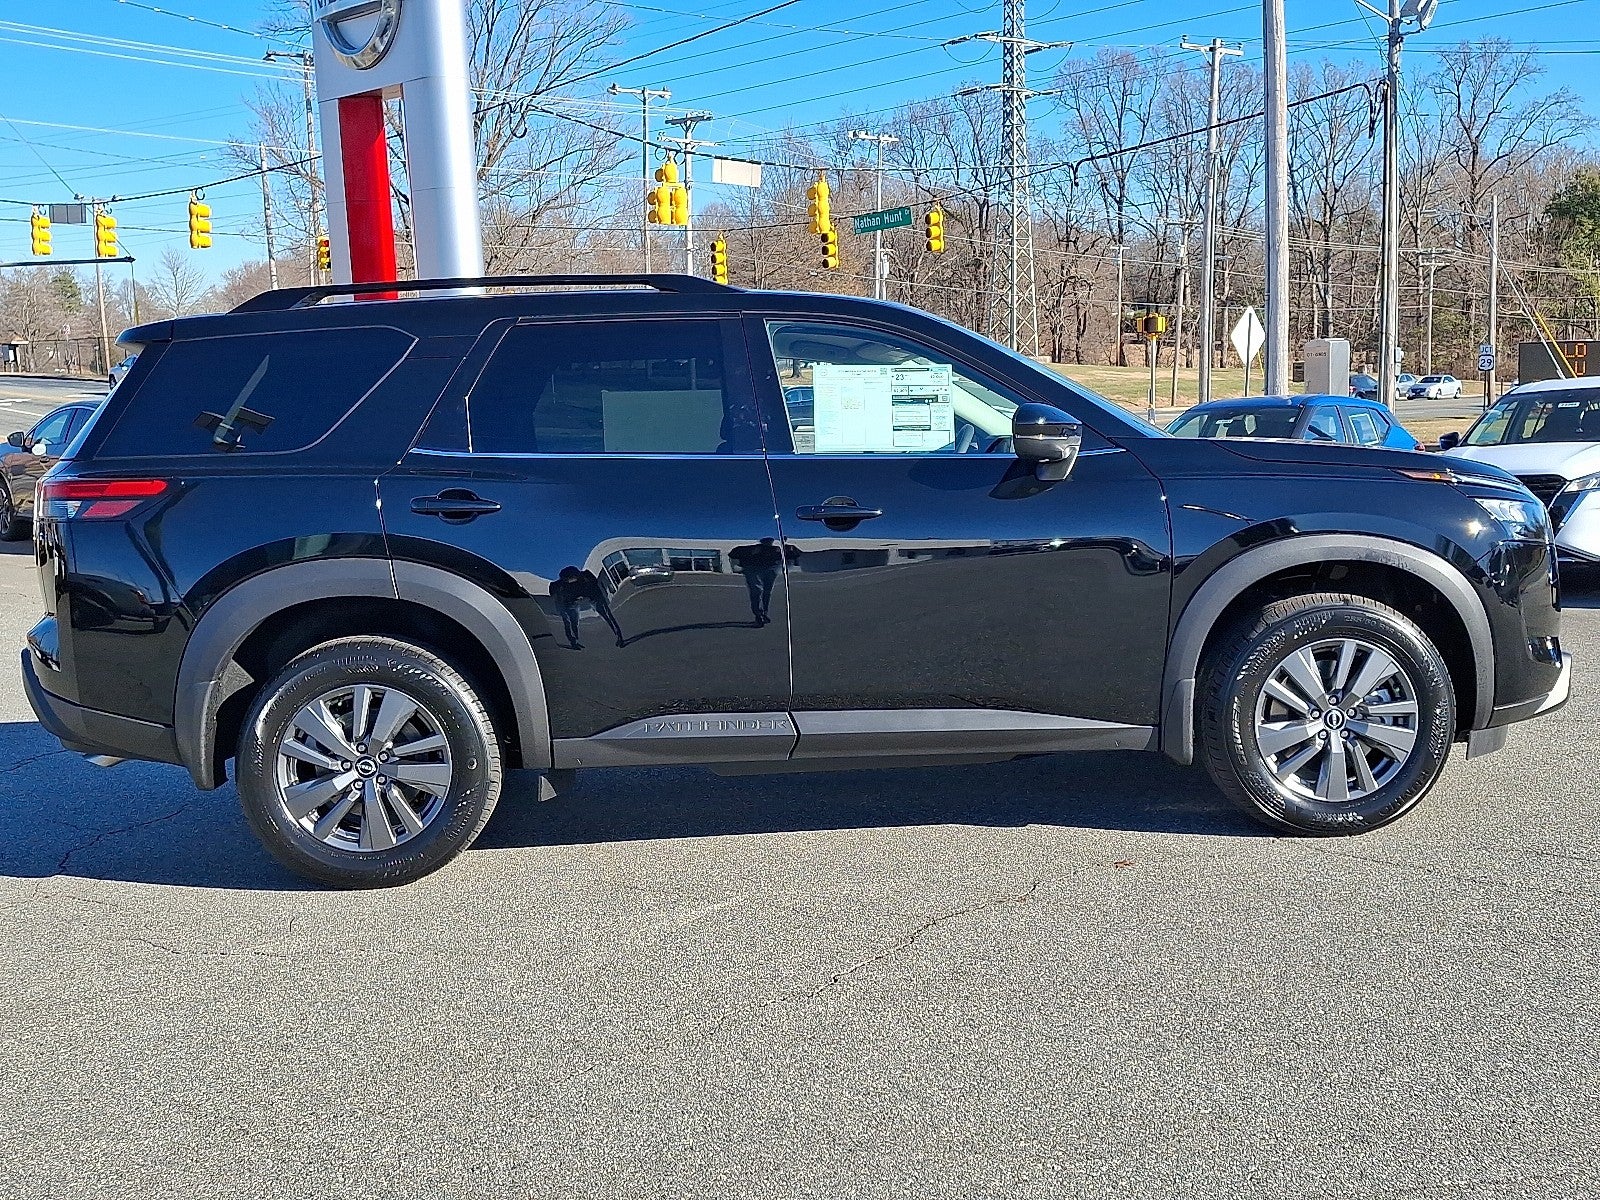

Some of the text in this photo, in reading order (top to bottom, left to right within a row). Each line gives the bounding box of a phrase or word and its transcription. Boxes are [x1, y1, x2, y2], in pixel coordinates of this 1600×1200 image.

[854, 216, 881, 229] Nathan
[883, 210, 903, 225] Hunt
[1480, 358, 1492, 368] 29
[642, 719, 788, 733] PATHFINDER
